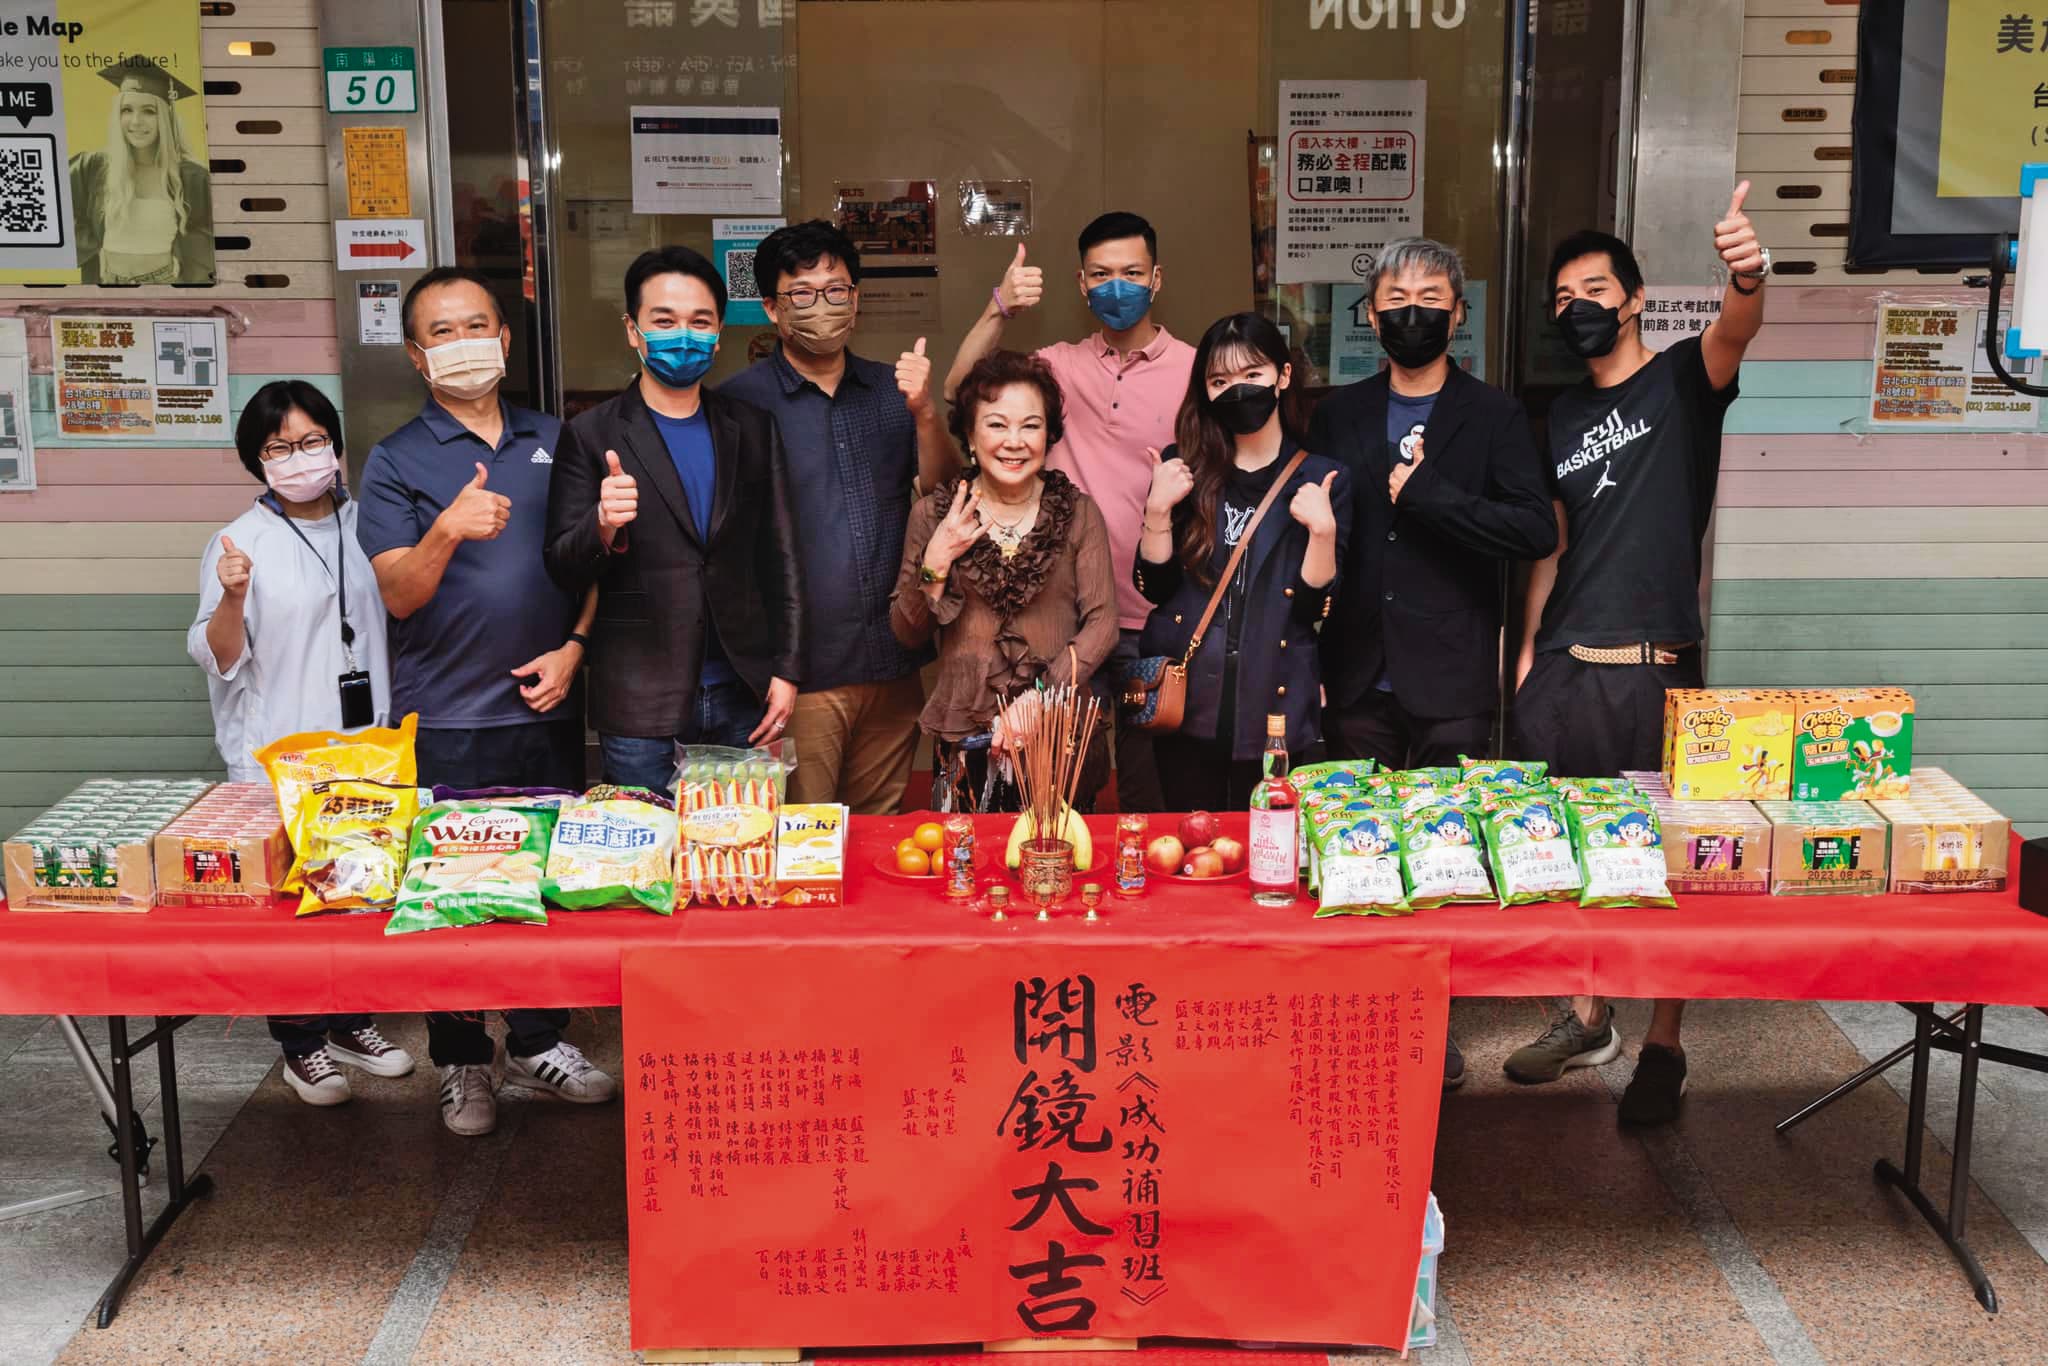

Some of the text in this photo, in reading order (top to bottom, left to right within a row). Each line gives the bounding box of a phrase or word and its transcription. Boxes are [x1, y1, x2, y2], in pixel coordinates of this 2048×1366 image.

[26, 16, 84, 43] Map
[28, 58, 59, 71] you
[64, 54, 81, 68] to
[86, 52, 113, 68] the
[118, 52, 169, 68] future
[336, 52, 403, 67] 南陽街
[9, 91, 37, 107] ME
[346, 75, 396, 105] 50
[1297, 153, 1407, 172] 務必全程配戴
[1556, 418, 1652, 480] BASKETBALL
[1682, 706, 1734, 729] Cheetos
[1801, 706, 1852, 729] Cheetos
[468, 815, 520, 828] Cream
[783, 819, 837, 831] Yu-Ki
[422, 824, 529, 844] Wafer
[558, 822, 655, 848] 蔬菜蘇打
[1264, 991, 1281, 1040] 出品人
[1408, 986, 1425, 1064] 出品公司
[638, 1052, 657, 1092] 編劇
[997, 974, 1114, 1334] 開鏡大吉
[1106, 983, 1168, 1306] 電影《成功補習班》
